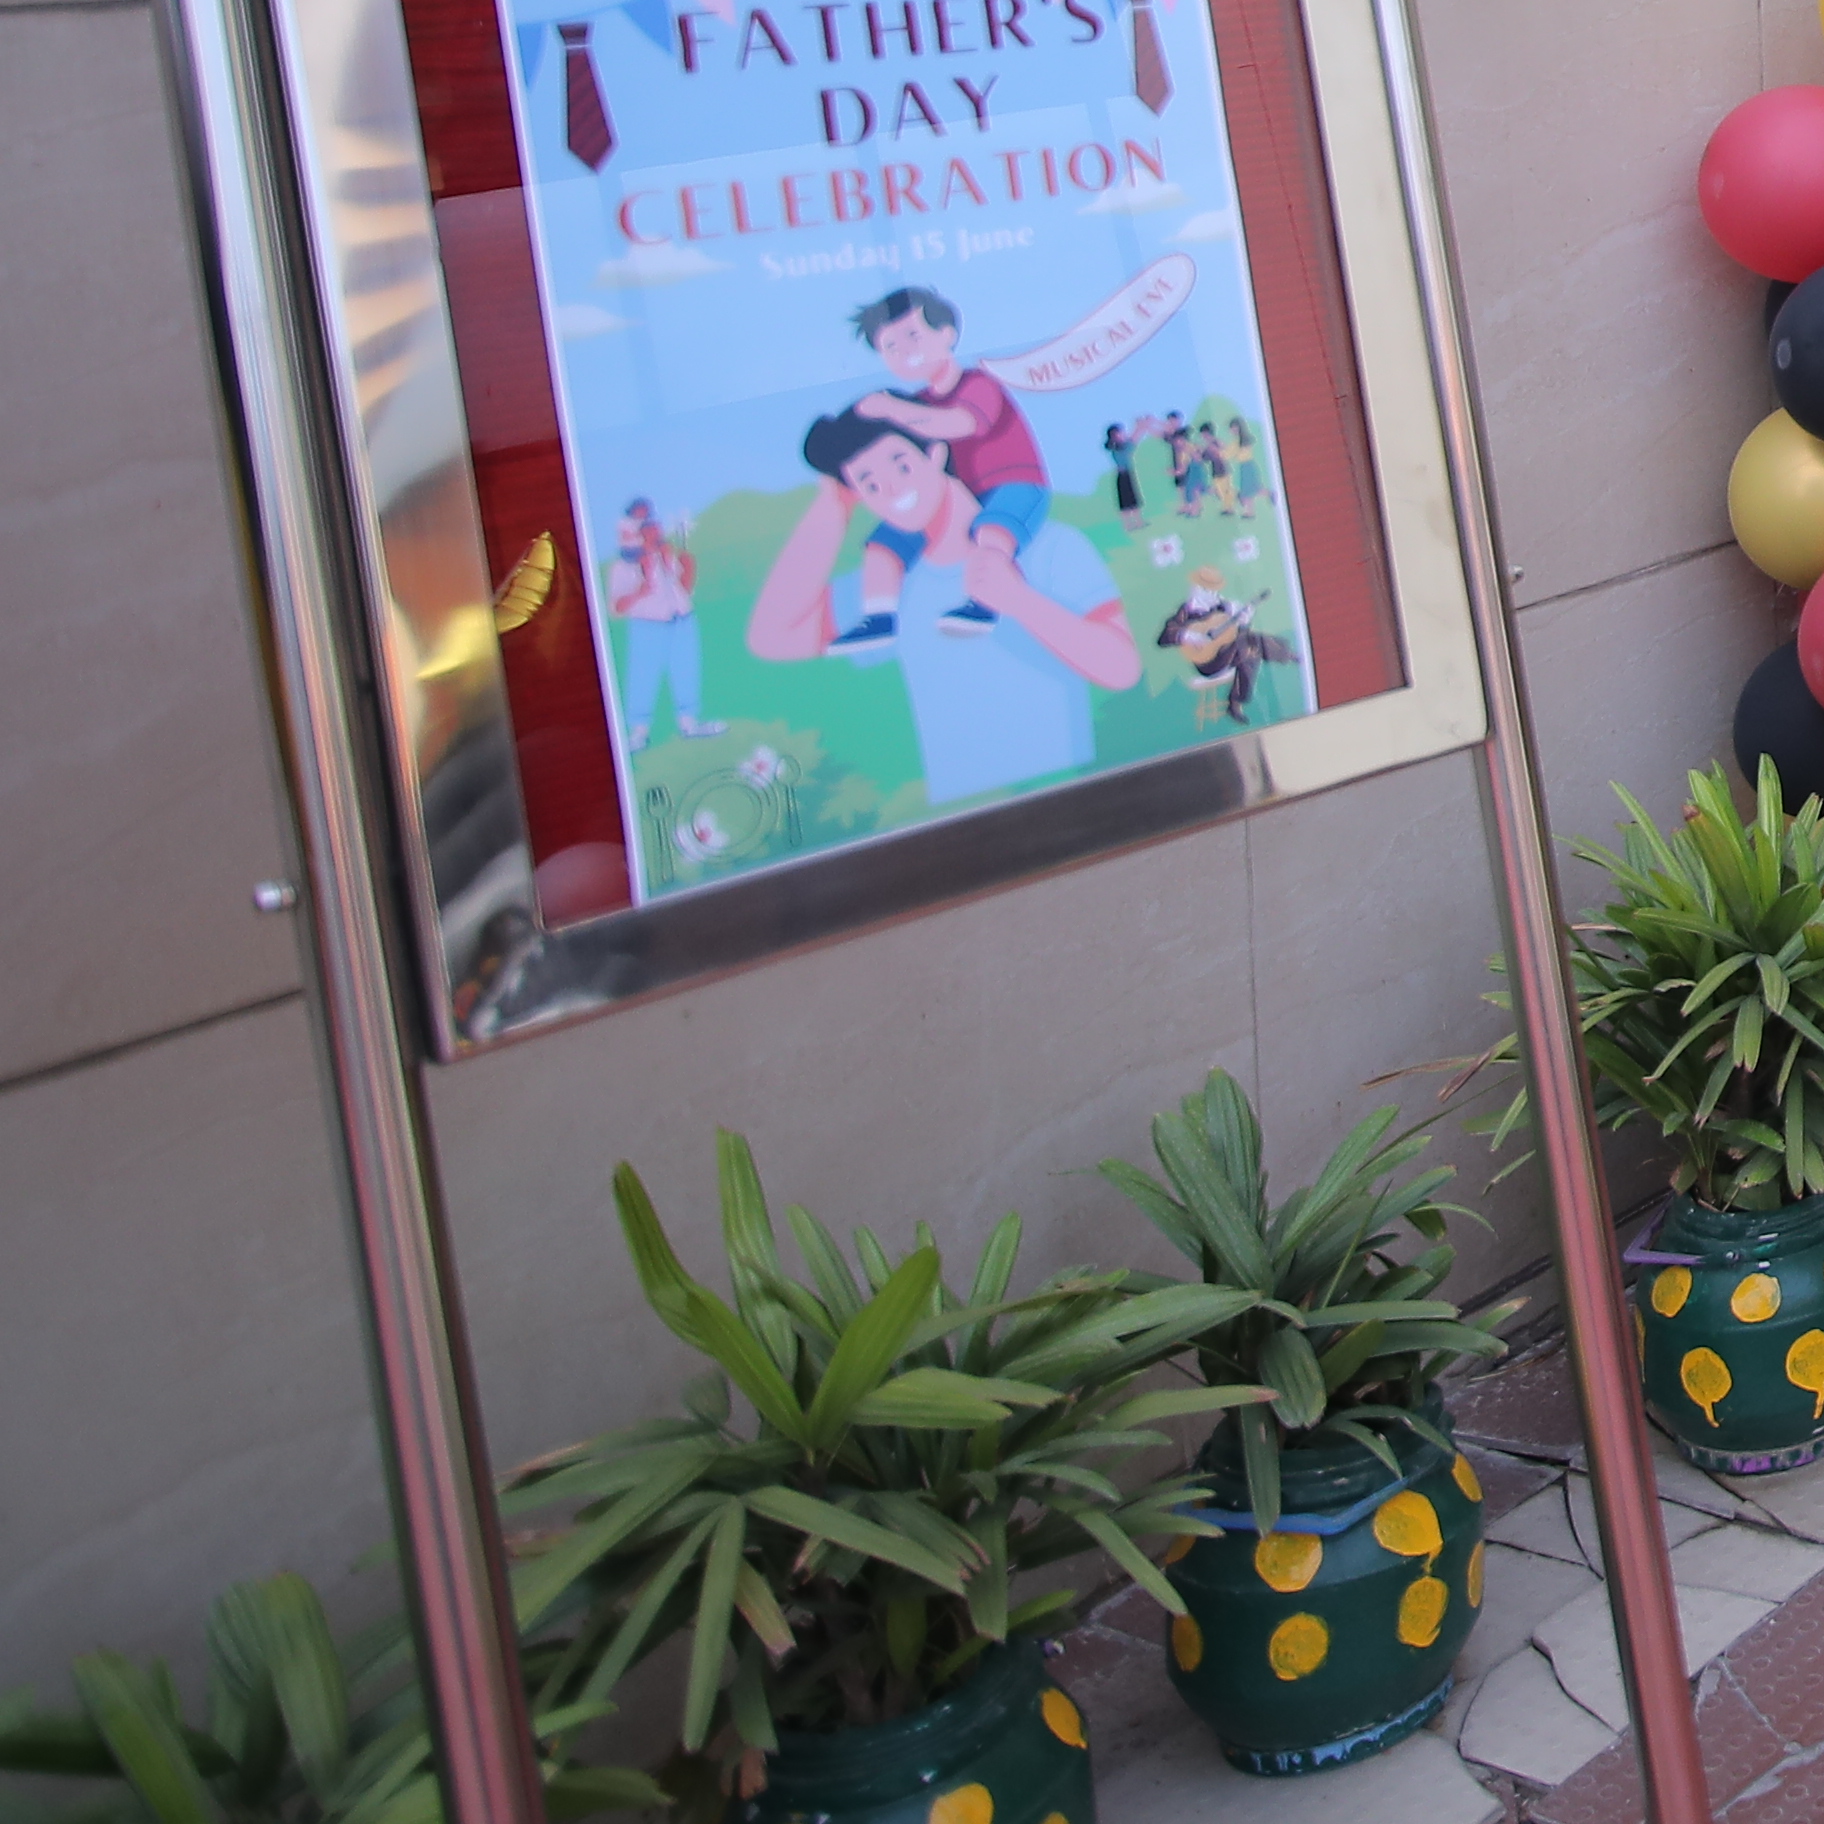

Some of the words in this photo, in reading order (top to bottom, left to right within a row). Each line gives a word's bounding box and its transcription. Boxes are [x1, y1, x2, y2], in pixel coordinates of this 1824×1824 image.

[819, 75, 1000, 147] DAY
[616, 135, 1170, 246] CELEBRATION
[759, 242, 901, 279] Sunday
[911, 229, 946, 261] 15
[956, 226, 1035, 263] June
[1028, 320, 1137, 386] MUSICAL
